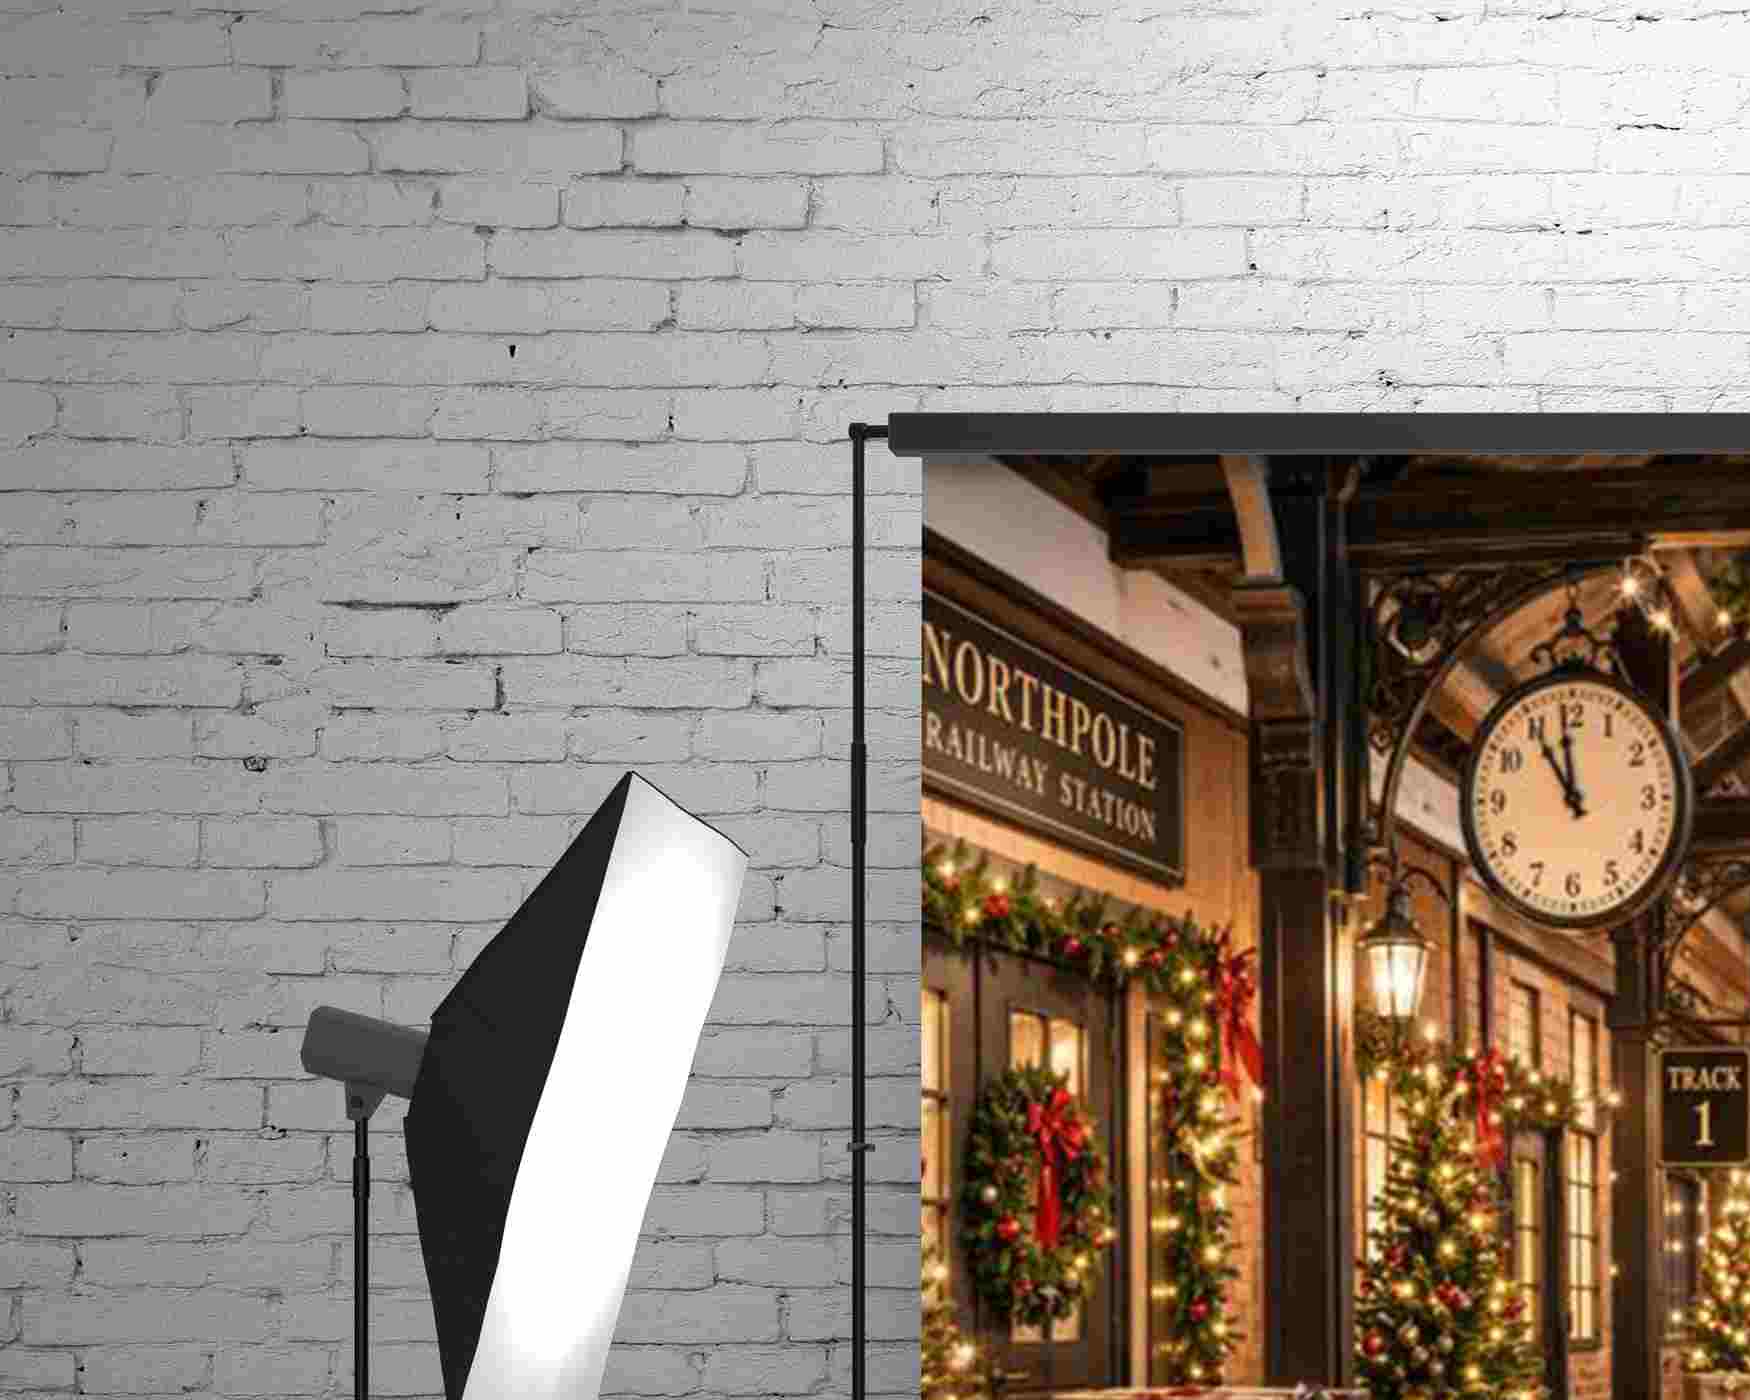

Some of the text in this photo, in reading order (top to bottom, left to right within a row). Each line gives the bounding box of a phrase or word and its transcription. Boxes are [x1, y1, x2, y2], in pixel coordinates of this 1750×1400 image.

[922, 622, 1157, 791] NORTHPOLE
[1500, 747, 1522, 774] 10
[1628, 742, 1645, 768] 2
[925, 711, 1156, 841] RAILWAY STATION
[1490, 788, 1505, 816] 9
[1640, 783, 1656, 811] 3
[1501, 831, 1518, 857] 8
[1627, 828, 1643, 855] 4
[1529, 860, 1544, 888] 7
[1564, 871, 1581, 897] 6
[1603, 860, 1619, 887] 5
[1667, 1065, 1742, 1092] TRACK
[1694, 1100, 1715, 1147] 1
